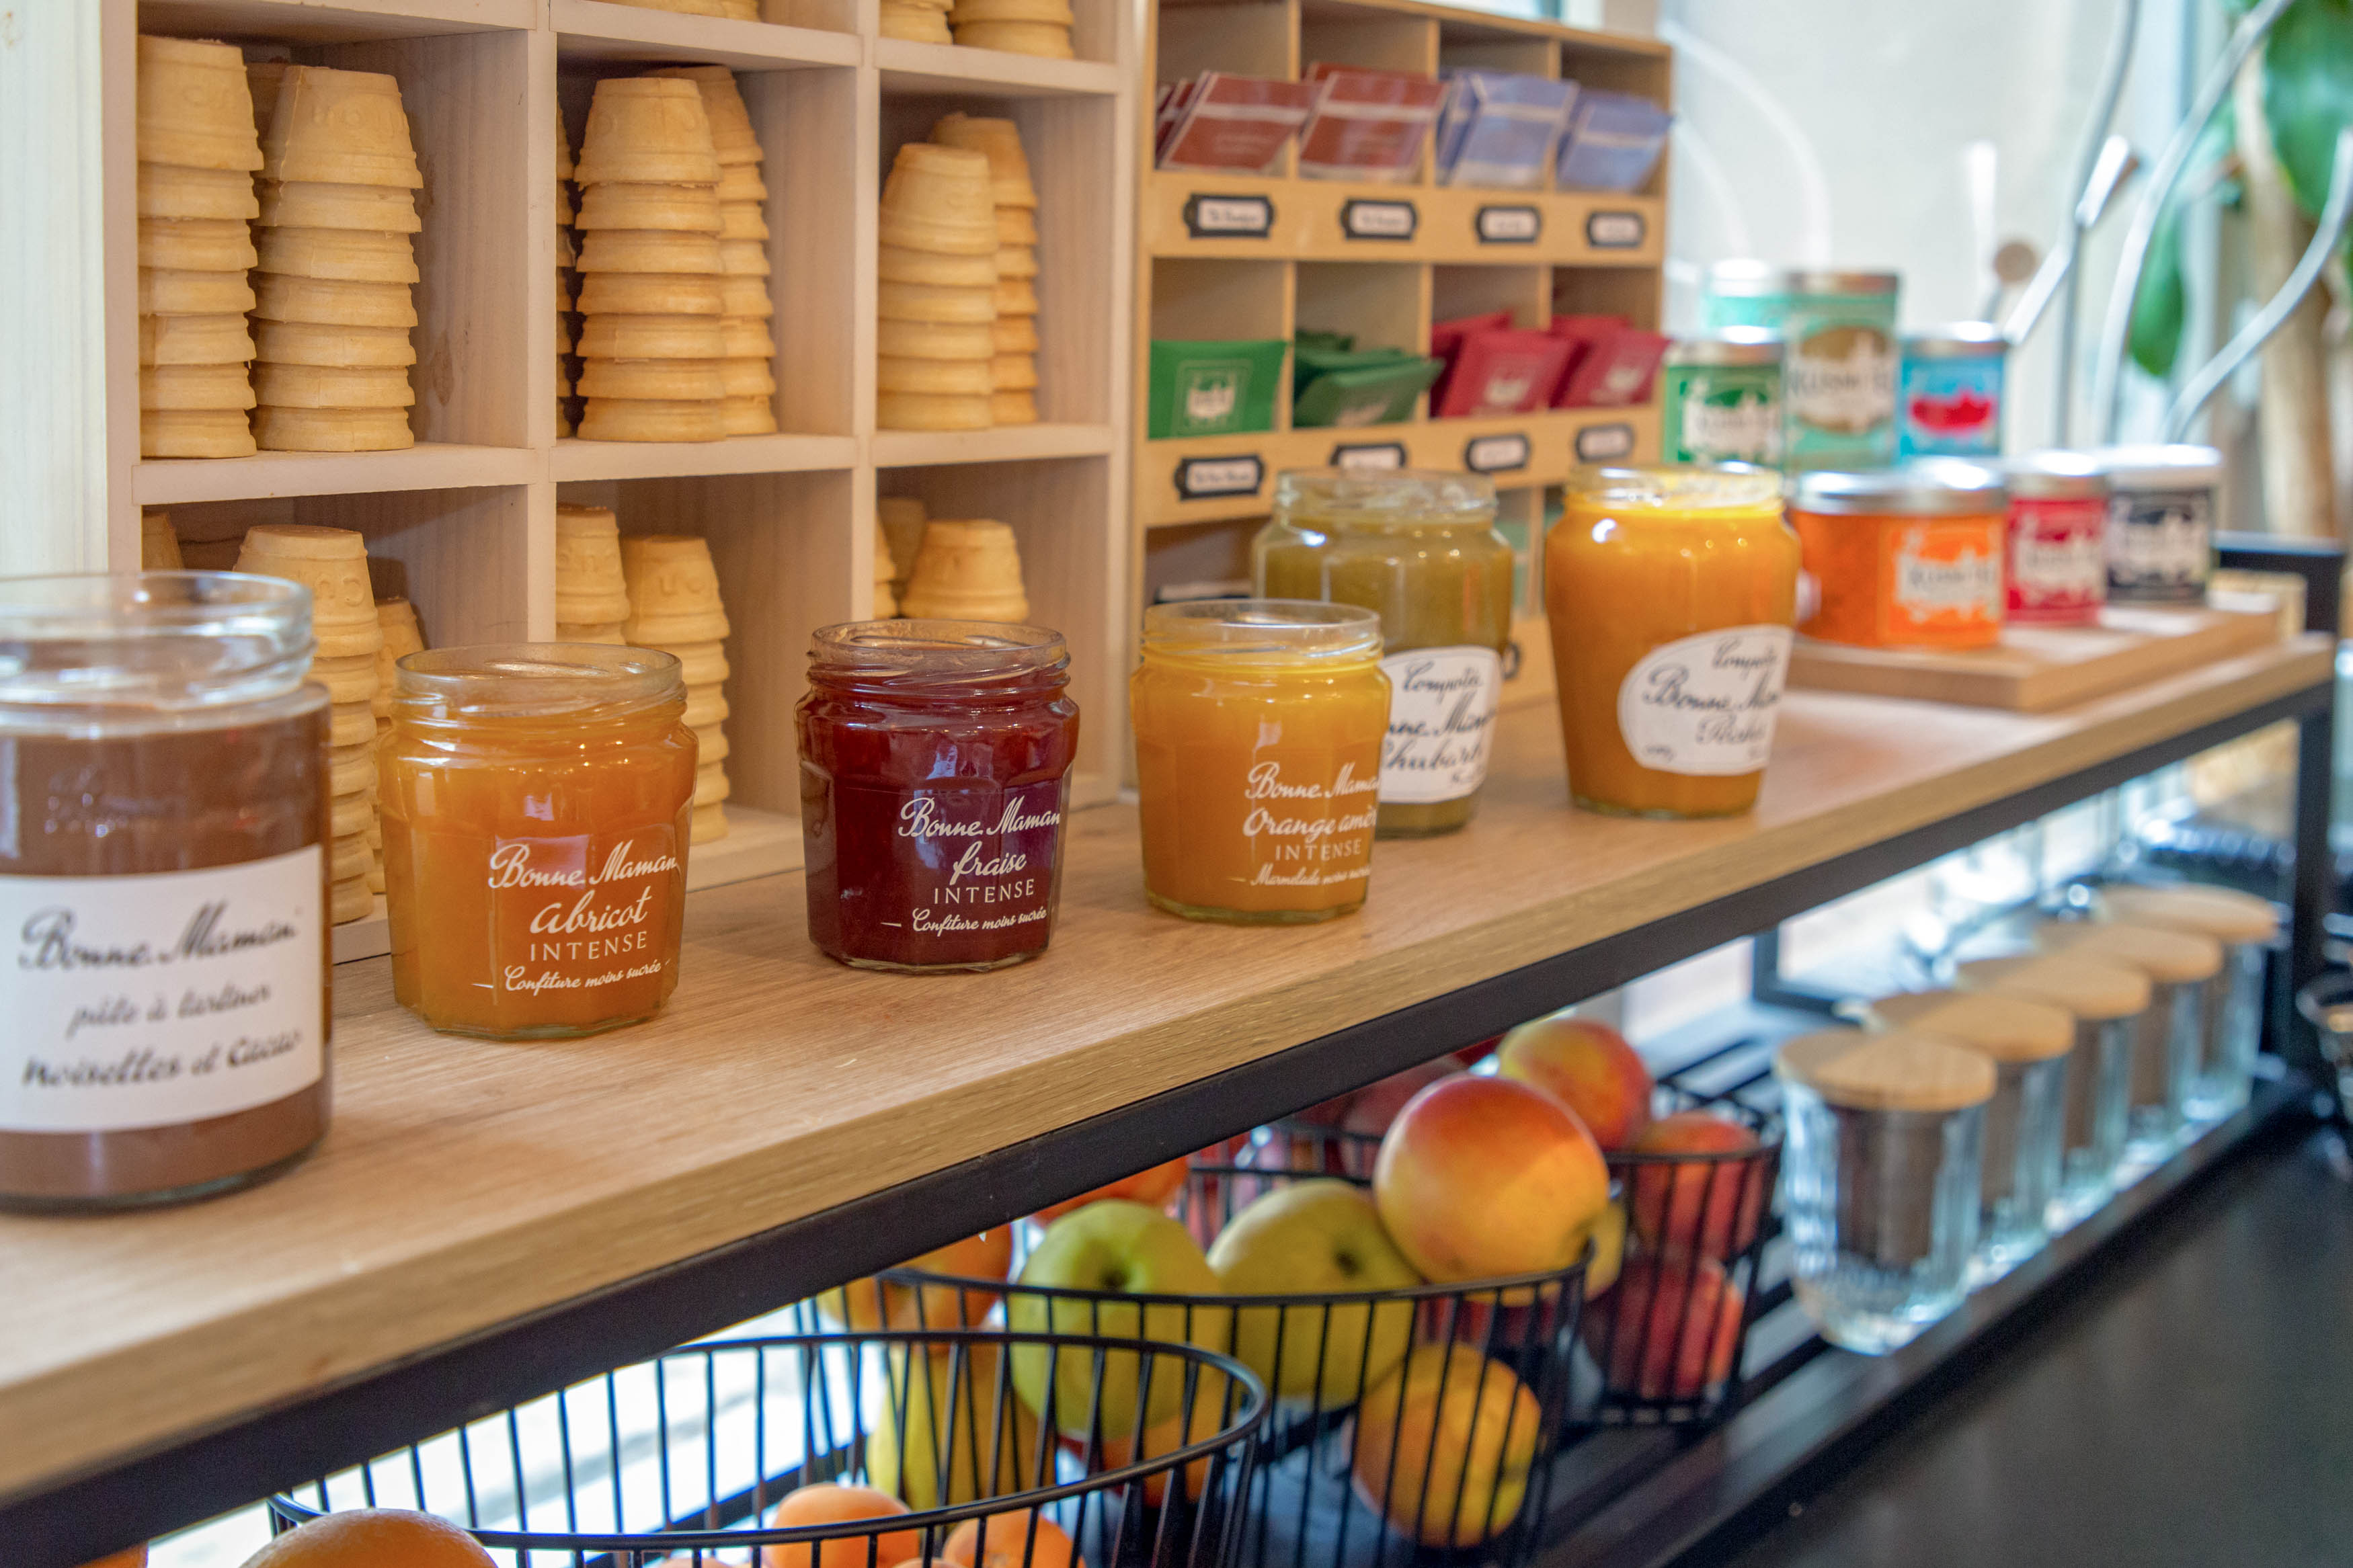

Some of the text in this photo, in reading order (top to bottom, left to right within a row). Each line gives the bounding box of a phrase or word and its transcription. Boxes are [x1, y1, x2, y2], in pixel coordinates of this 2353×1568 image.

[1245, 761, 1379, 798] Bonne Mama
[898, 795, 1060, 837] Bonne Maman
[1242, 807, 1336, 844] Orange
[488, 839, 678, 889] Bonne Maman
[1275, 838, 1361, 861] INTENSE
[934, 878, 1034, 904] INTENSE
[19, 899, 299, 971] Bonne Maman
[912, 906, 1047, 937] Confiture moins sucrée
[530, 931, 647, 962] INTENSE
[505, 959, 662, 996] Confiture moins sucrée
